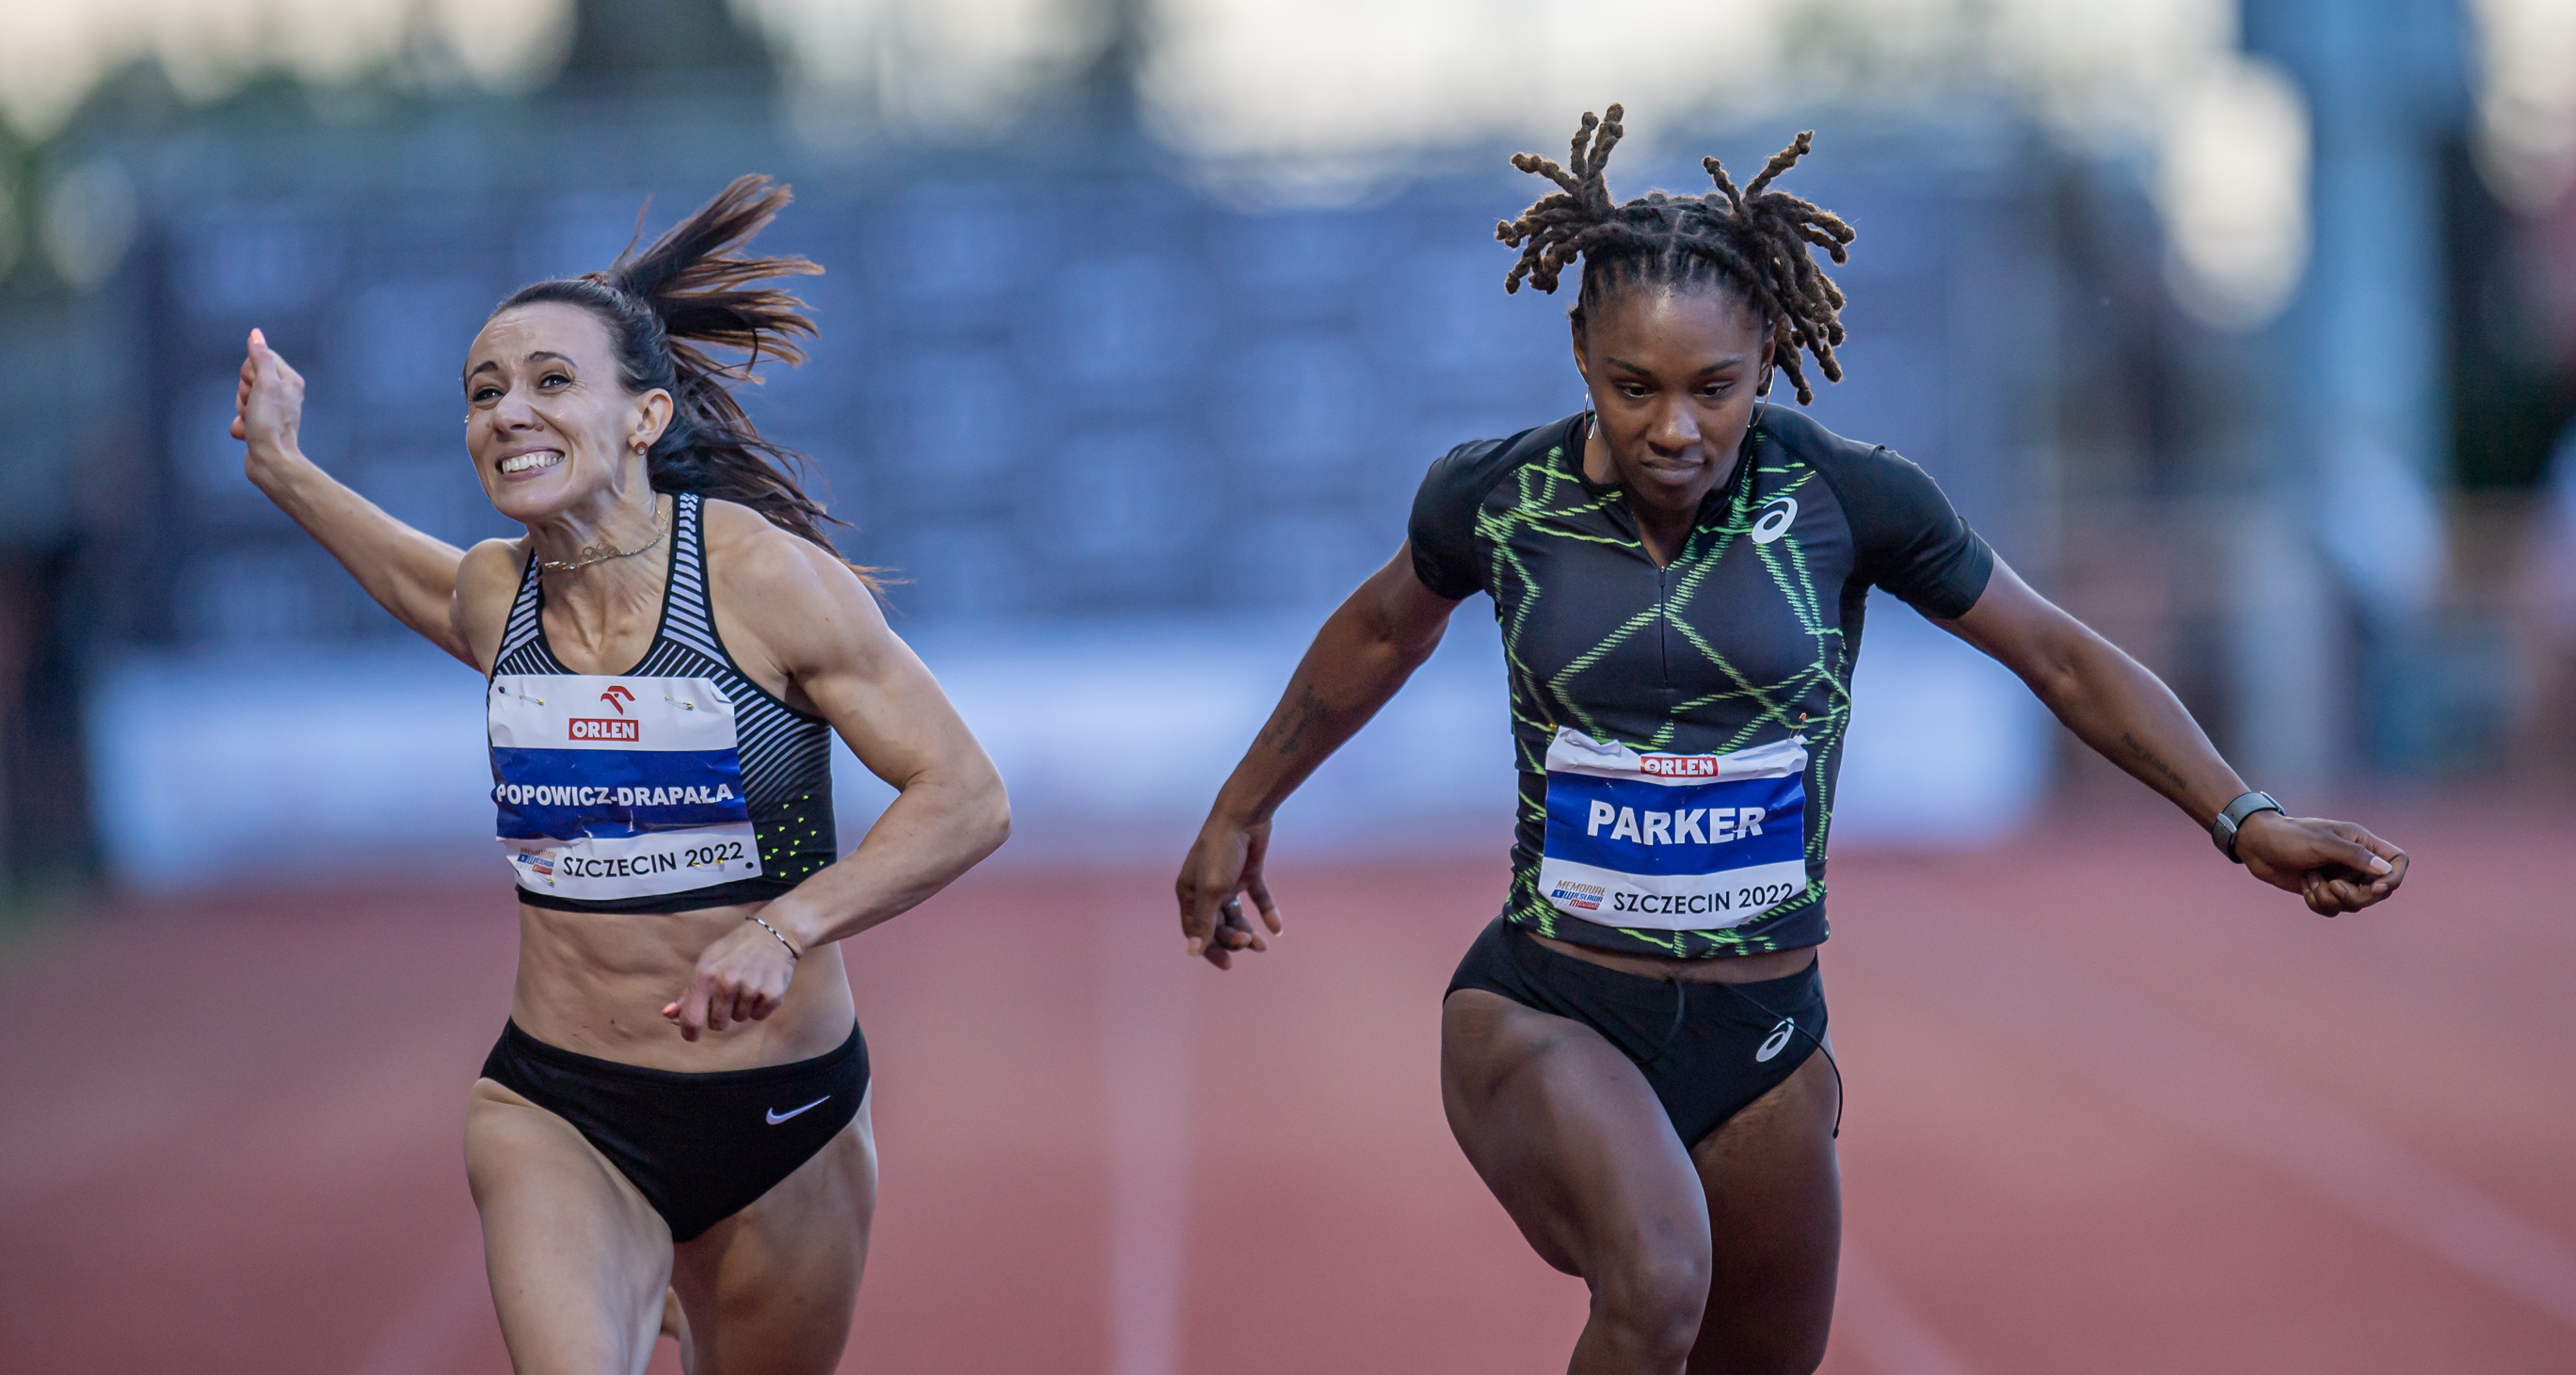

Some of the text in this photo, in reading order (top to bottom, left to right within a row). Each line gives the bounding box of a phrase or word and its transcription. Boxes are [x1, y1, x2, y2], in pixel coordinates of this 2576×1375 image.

[571, 721, 635, 739] ORLEN
[1643, 758, 1716, 776] ORLEN
[496, 783, 734, 807] POPOWICZ-DRAPAŁA
[1587, 799, 1767, 846] PARKER
[563, 852, 678, 878] SZCZECIN
[684, 841, 744, 868] 2022
[1613, 882, 1794, 915] SZCZECIN 2022
